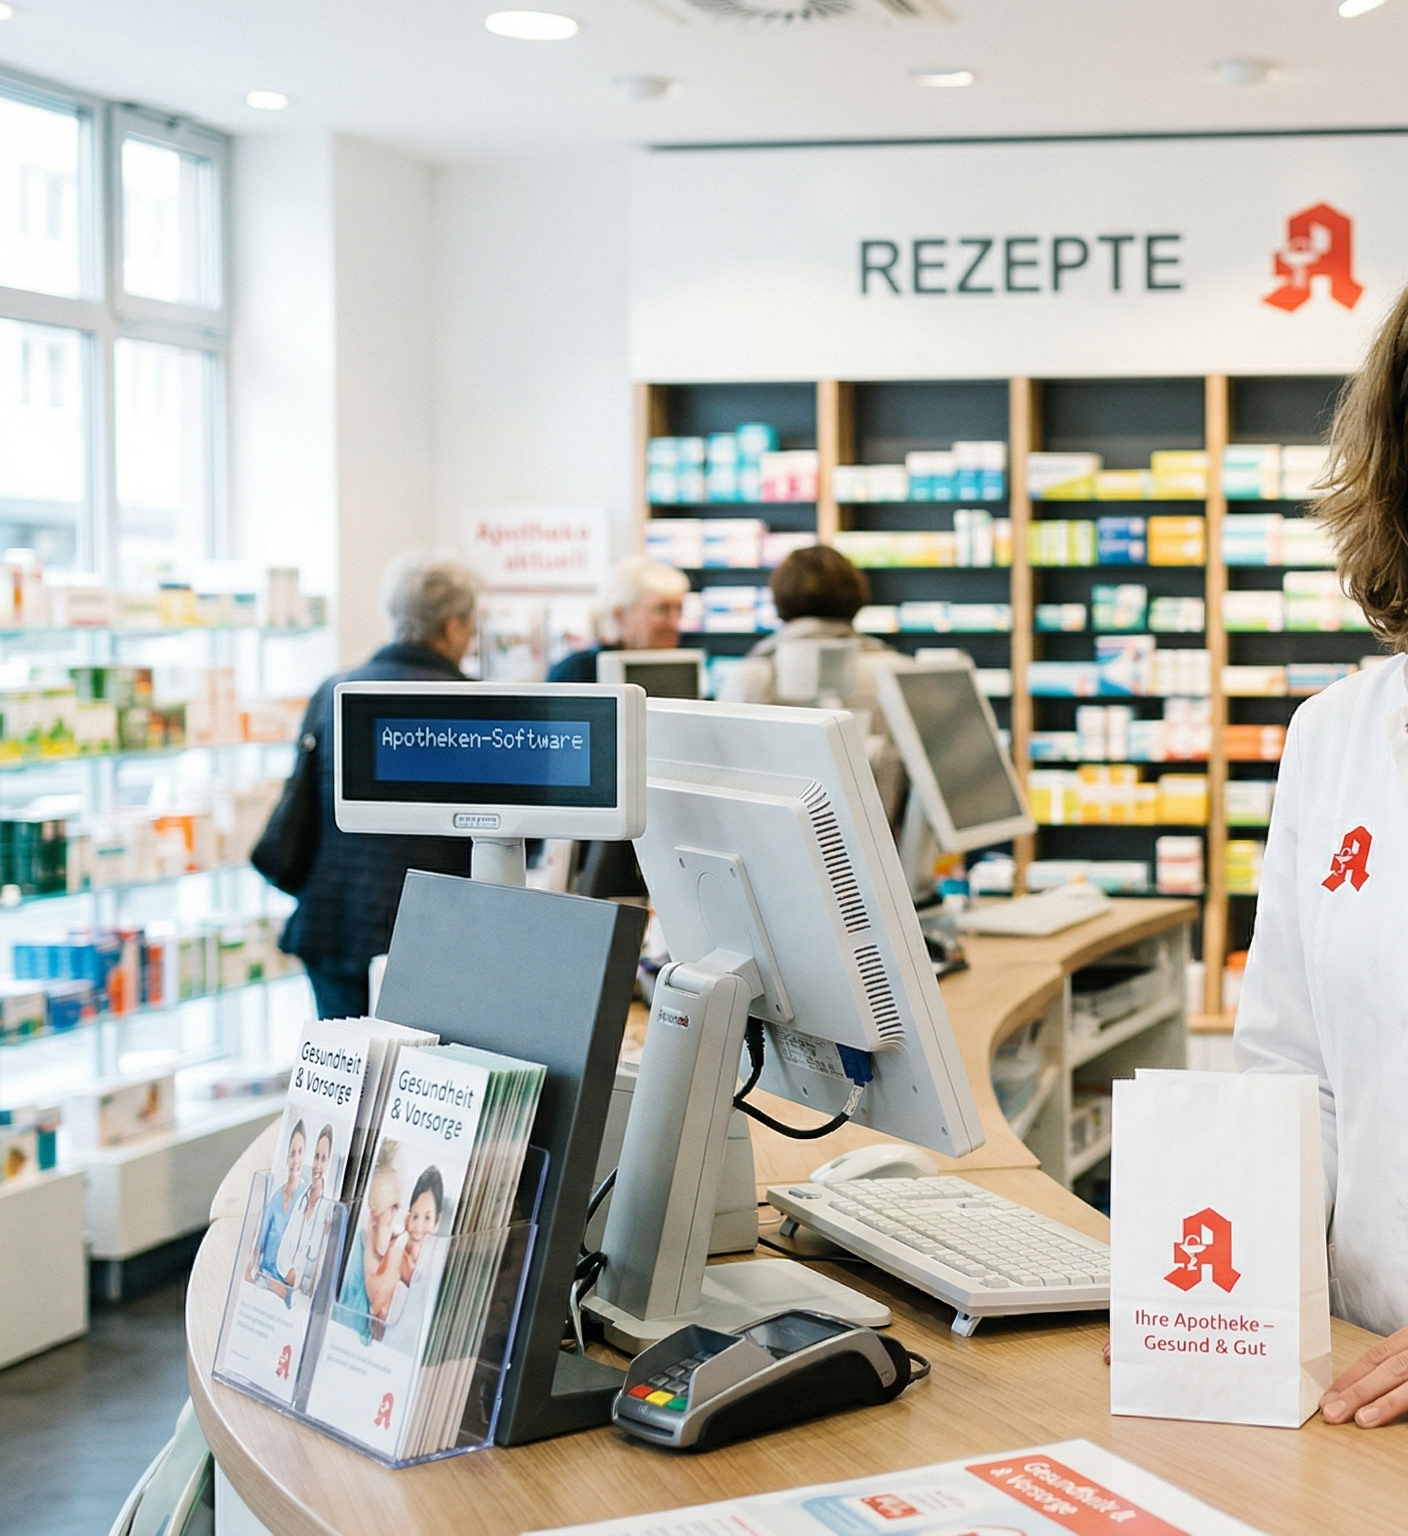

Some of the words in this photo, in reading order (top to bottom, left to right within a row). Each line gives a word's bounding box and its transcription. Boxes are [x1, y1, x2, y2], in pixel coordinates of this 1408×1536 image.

[860, 234, 1182, 295] REZEPTE
[382, 726, 583, 750] Apotheken-Software
[301, 1041, 362, 1075] Gesundheit
[295, 1067, 304, 1089] &
[306, 1070, 352, 1105] Vorsorge
[399, 1070, 475, 1109] Gesundheit
[390, 1097, 402, 1120] &
[405, 1101, 463, 1141] Vorsorge
[1134, 1309, 1169, 1328] Ihre
[1174, 1312, 1259, 1332] Apotheke
[1144, 1334, 1210, 1353] Gesund
[1215, 1339, 1228, 1355] &
[1233, 1339, 1267, 1356] Gut
